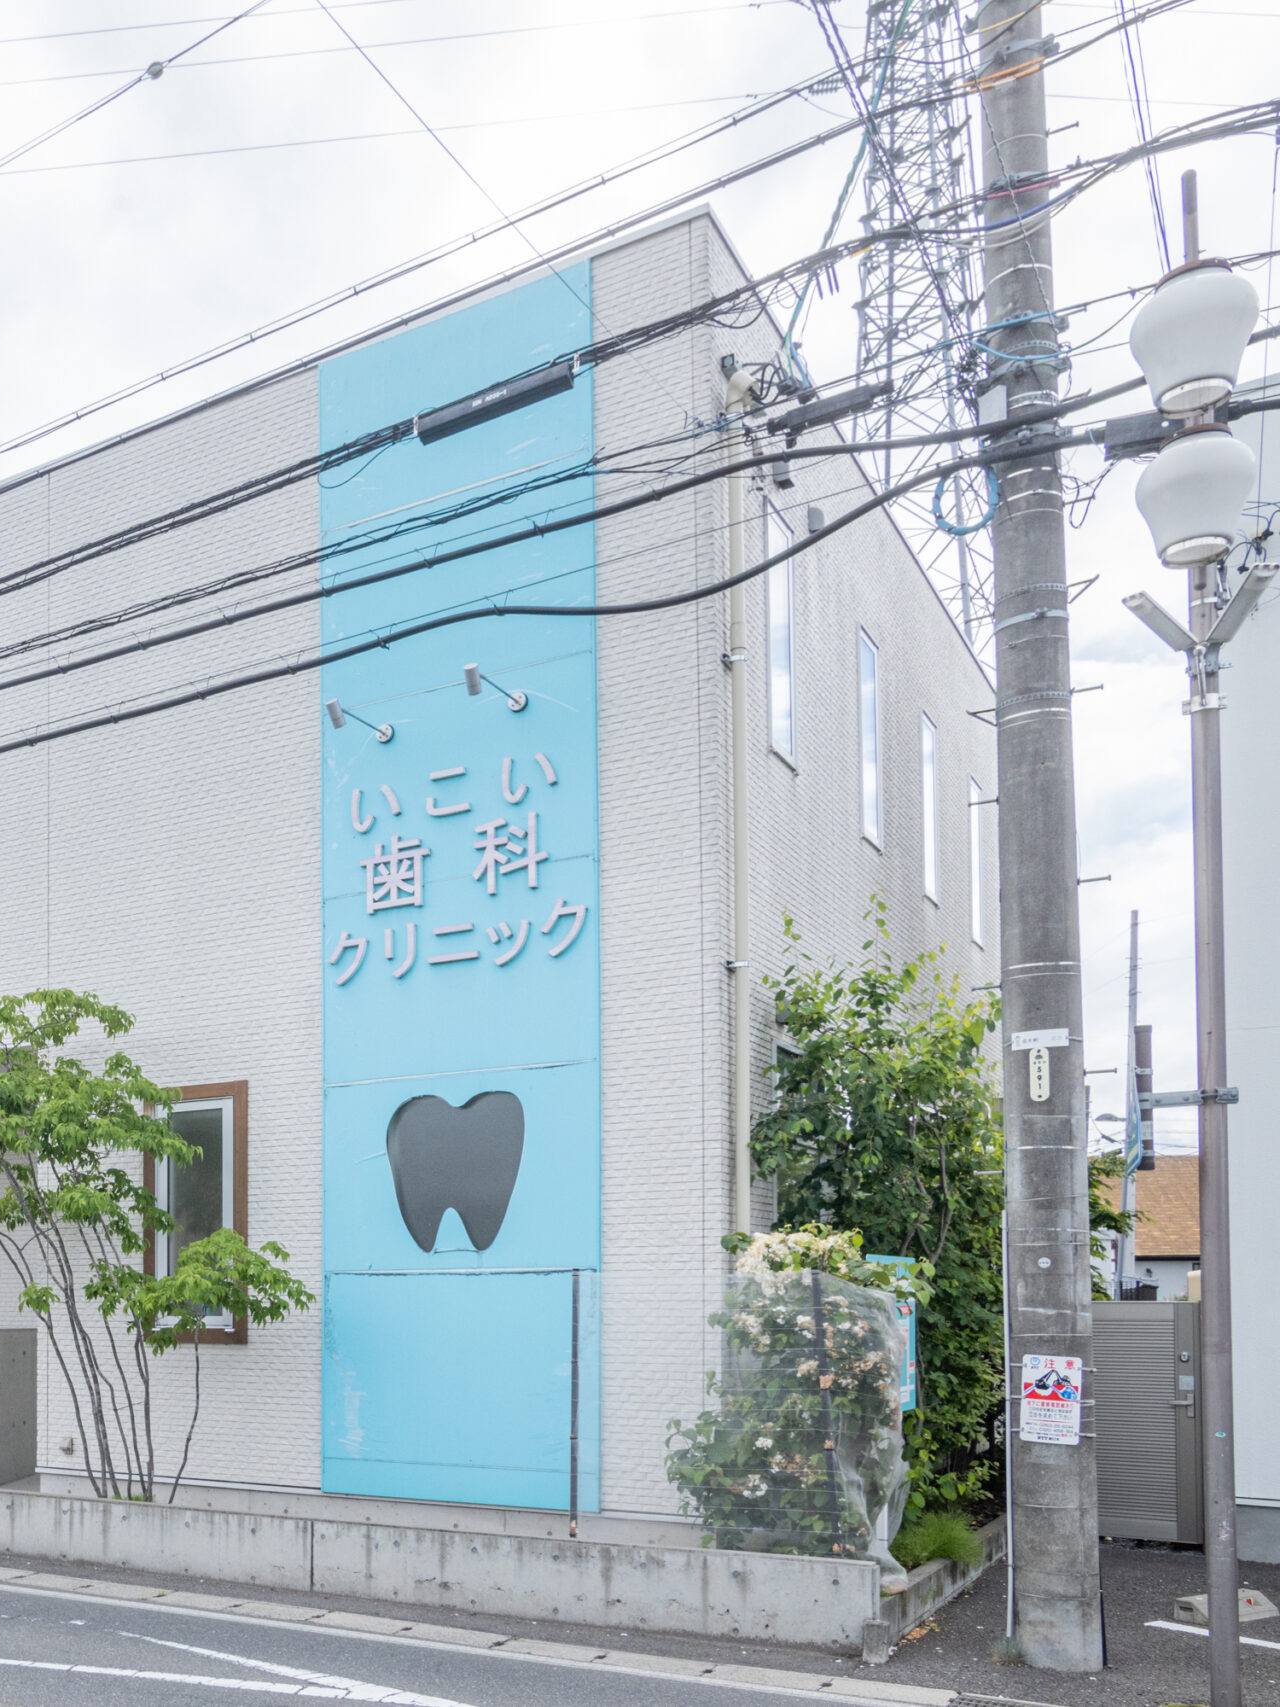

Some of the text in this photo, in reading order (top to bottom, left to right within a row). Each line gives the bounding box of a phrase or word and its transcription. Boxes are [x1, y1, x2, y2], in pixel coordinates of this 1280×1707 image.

[351, 752, 558, 834] いこい
[359, 811, 550, 915] 歯科
[329, 898, 588, 986] クリニック
